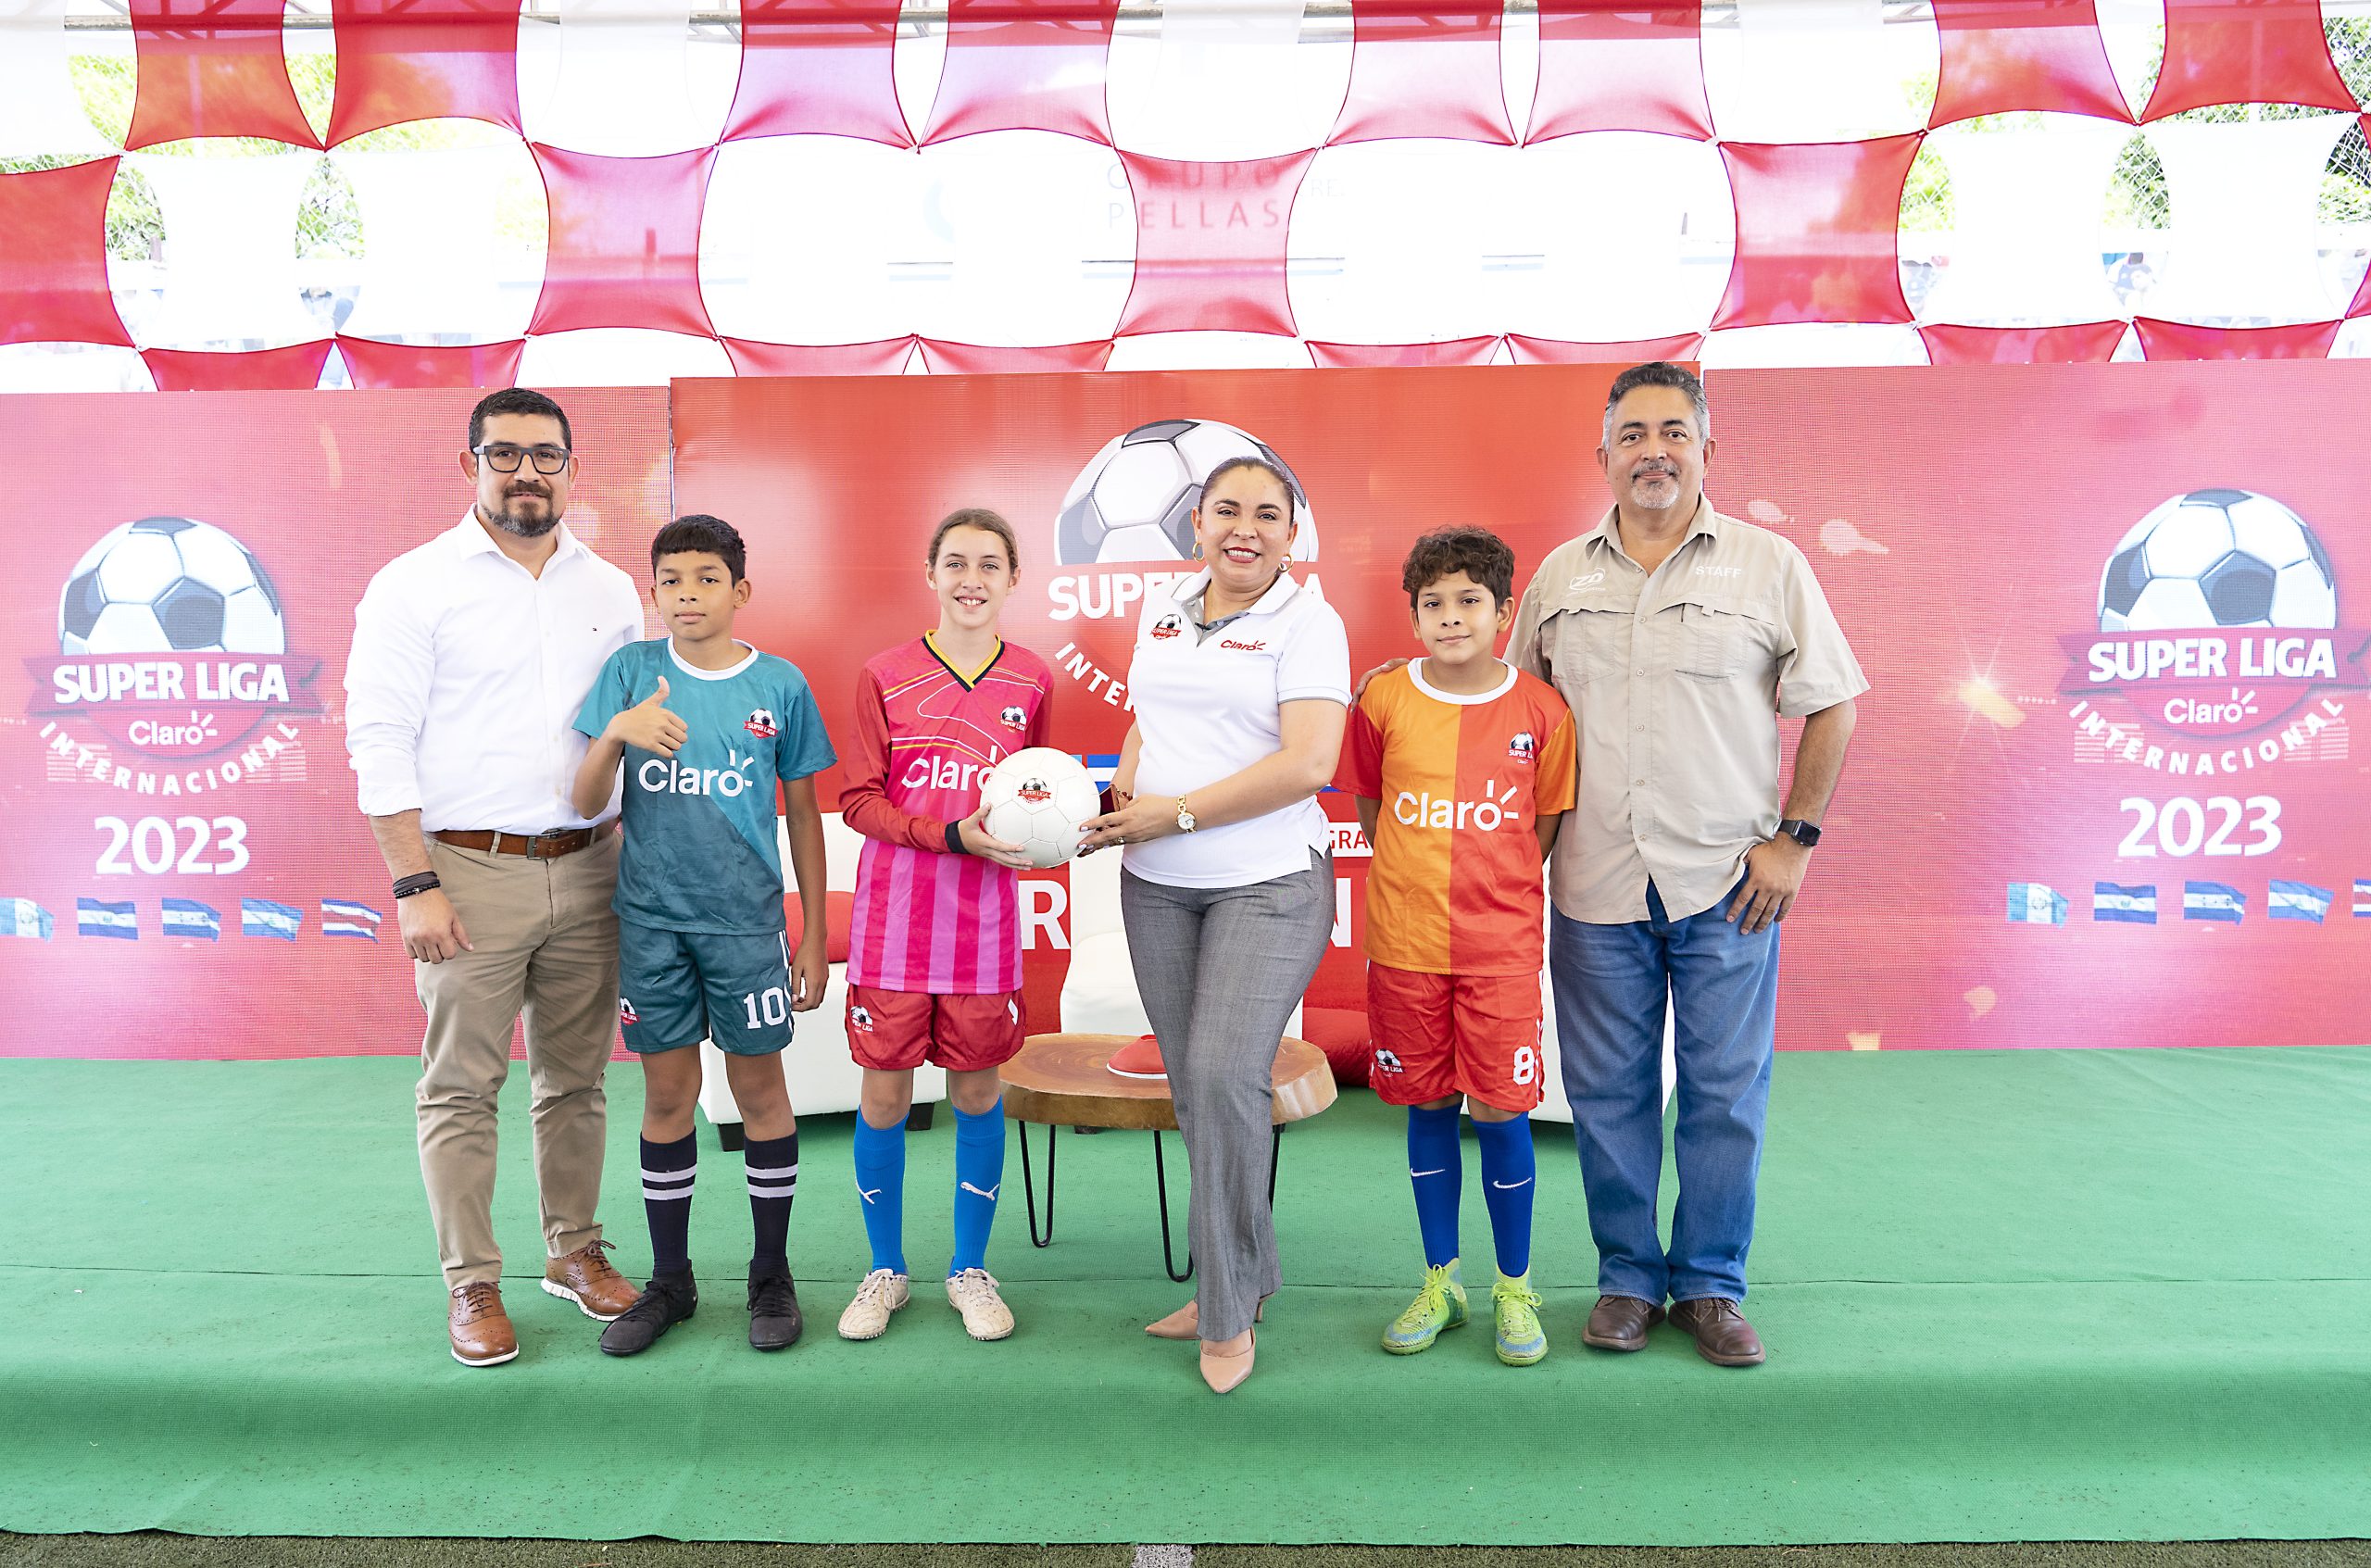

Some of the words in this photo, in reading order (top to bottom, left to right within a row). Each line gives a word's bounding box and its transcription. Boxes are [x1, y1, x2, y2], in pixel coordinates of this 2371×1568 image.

[1110, 200, 1280, 229] PELLAS
[1695, 565, 1742, 578] STAFF
[1221, 640, 1257, 651] Claro
[2089, 637, 2227, 683] SUPER
[2239, 637, 2337, 679] LIGA
[53, 661, 186, 703] SUPER
[195, 661, 290, 702] LIGA
[747, 722, 764, 732] SUPER
[763, 727, 776, 736] LIGA
[2164, 696, 2244, 723] Claro
[128, 719, 205, 746] Claro
[2069, 699, 2344, 775] INTERNACIONAL
[39, 721, 299, 796] INTERNACIONAL
[1508, 749, 1527, 758] SUPER
[637, 757, 746, 797] Claro
[1394, 789, 1503, 831] Claro
[2118, 796, 2283, 857] 2023
[94, 816, 250, 874] 2023
[744, 986, 786, 1029] 10
[1512, 1046, 1535, 1085] 8
